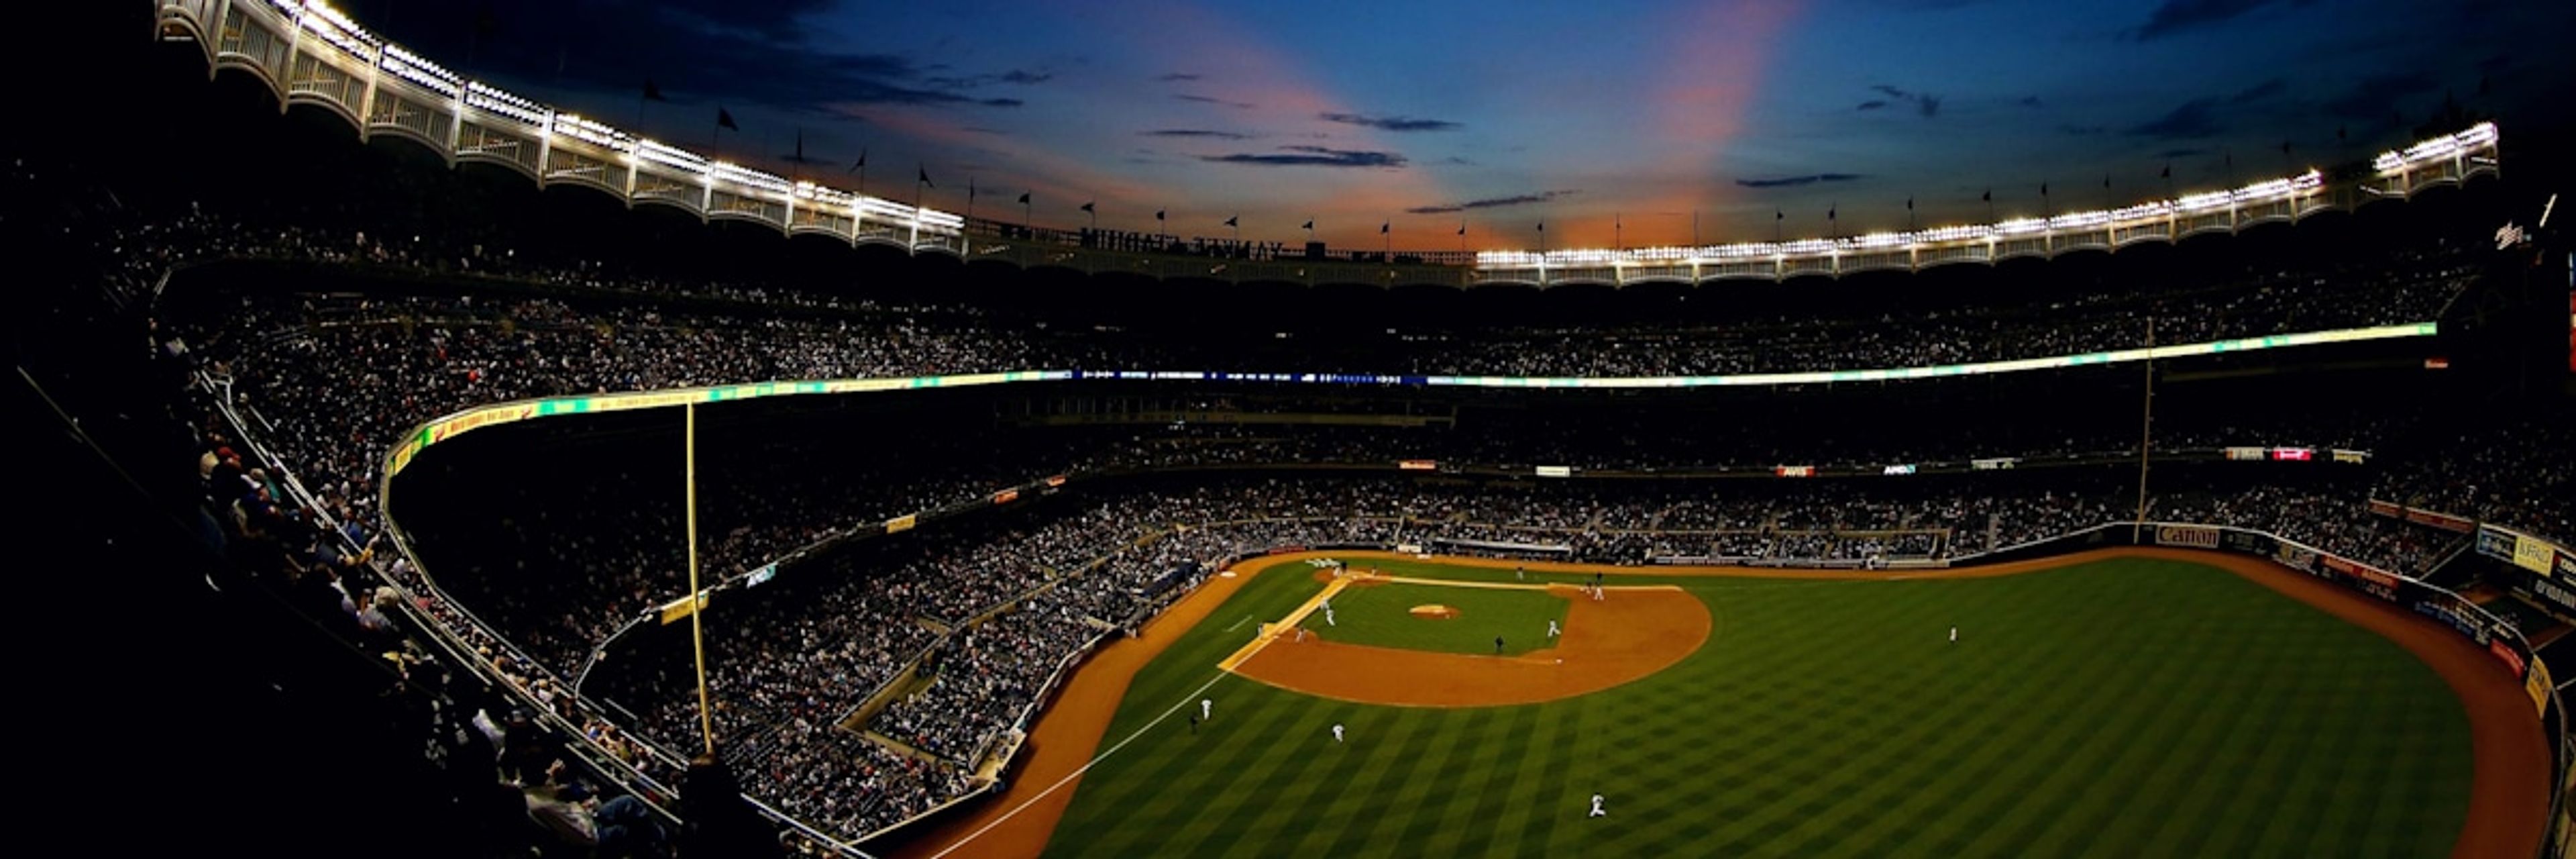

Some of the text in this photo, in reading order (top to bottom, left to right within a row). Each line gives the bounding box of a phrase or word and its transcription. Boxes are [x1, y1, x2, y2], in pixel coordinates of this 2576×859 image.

[1784, 466, 1807, 476] AVIS
[1884, 466, 1907, 474] AMD
[2159, 526, 2217, 545] Canon
